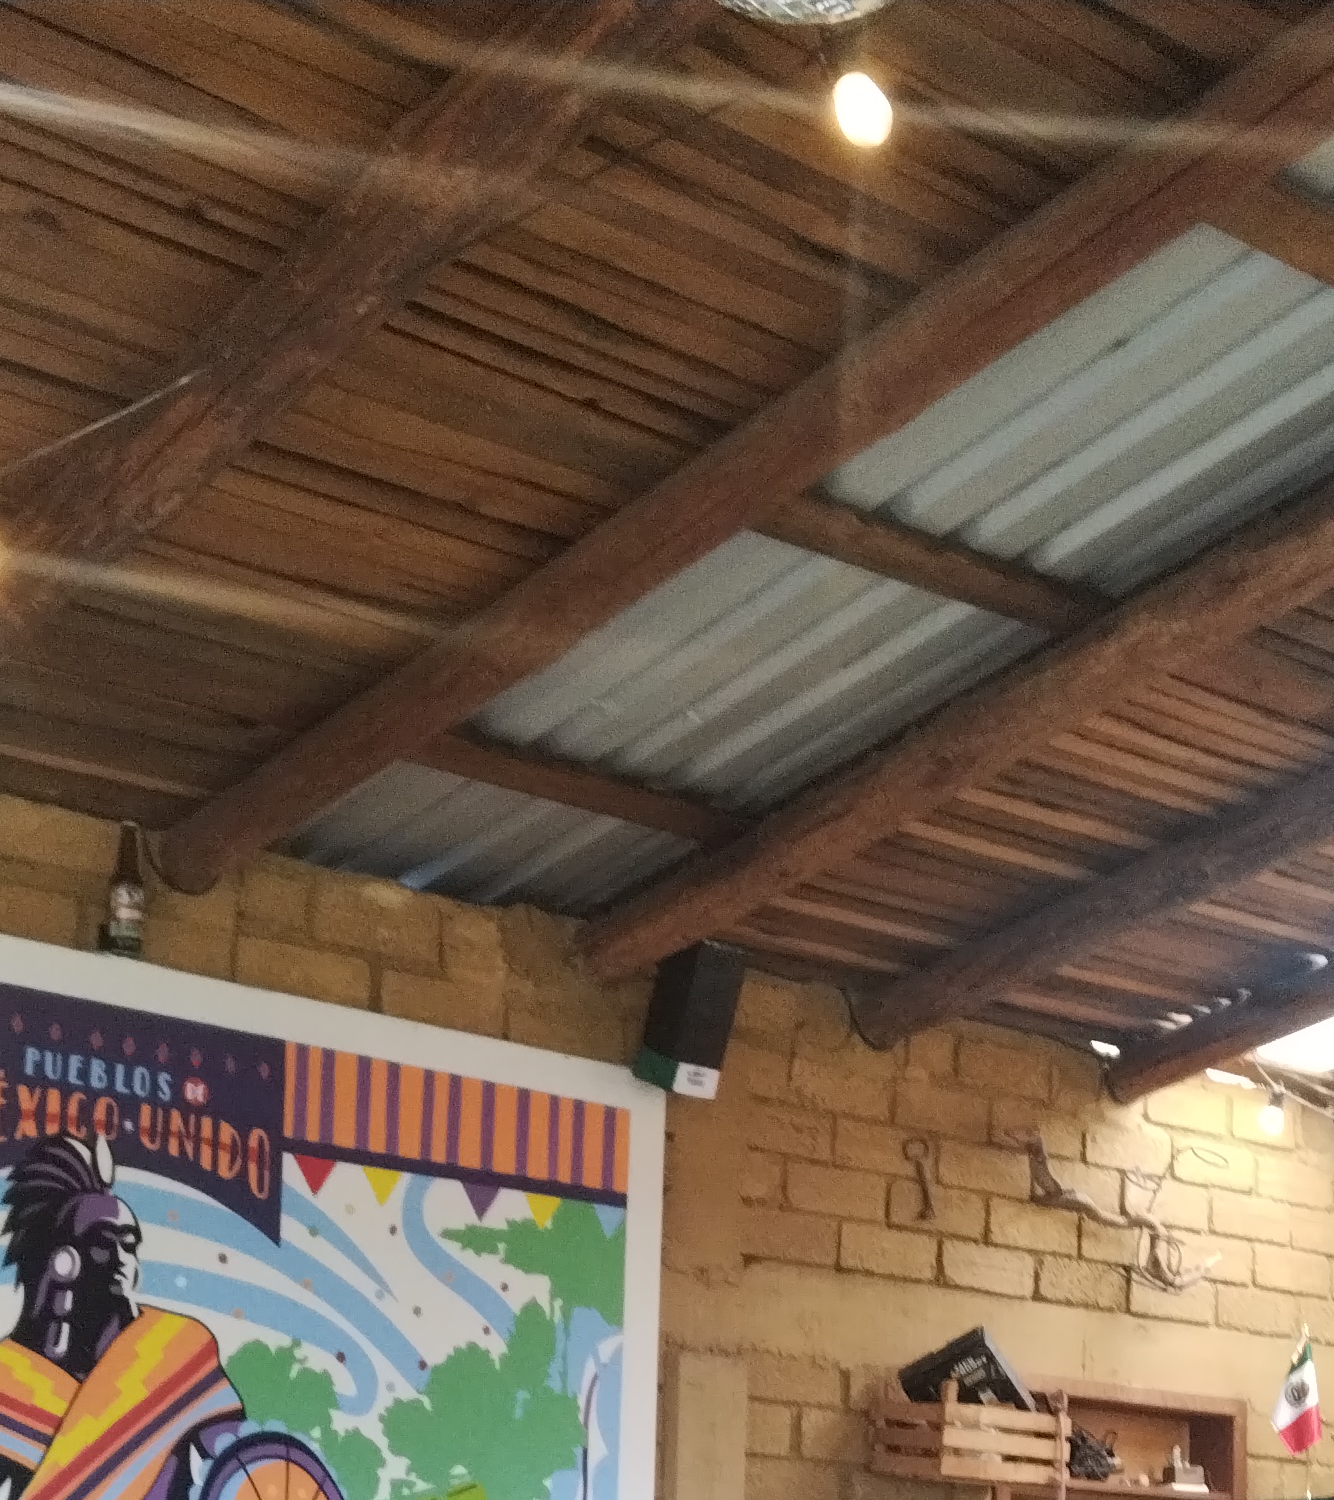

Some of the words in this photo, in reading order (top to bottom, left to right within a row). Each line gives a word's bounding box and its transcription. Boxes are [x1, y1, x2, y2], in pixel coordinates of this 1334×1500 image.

[23, 1046, 174, 1103] PUEBLOS
[184, 1080, 208, 1102] DE
[138, 1101, 272, 1200] UNIDO
